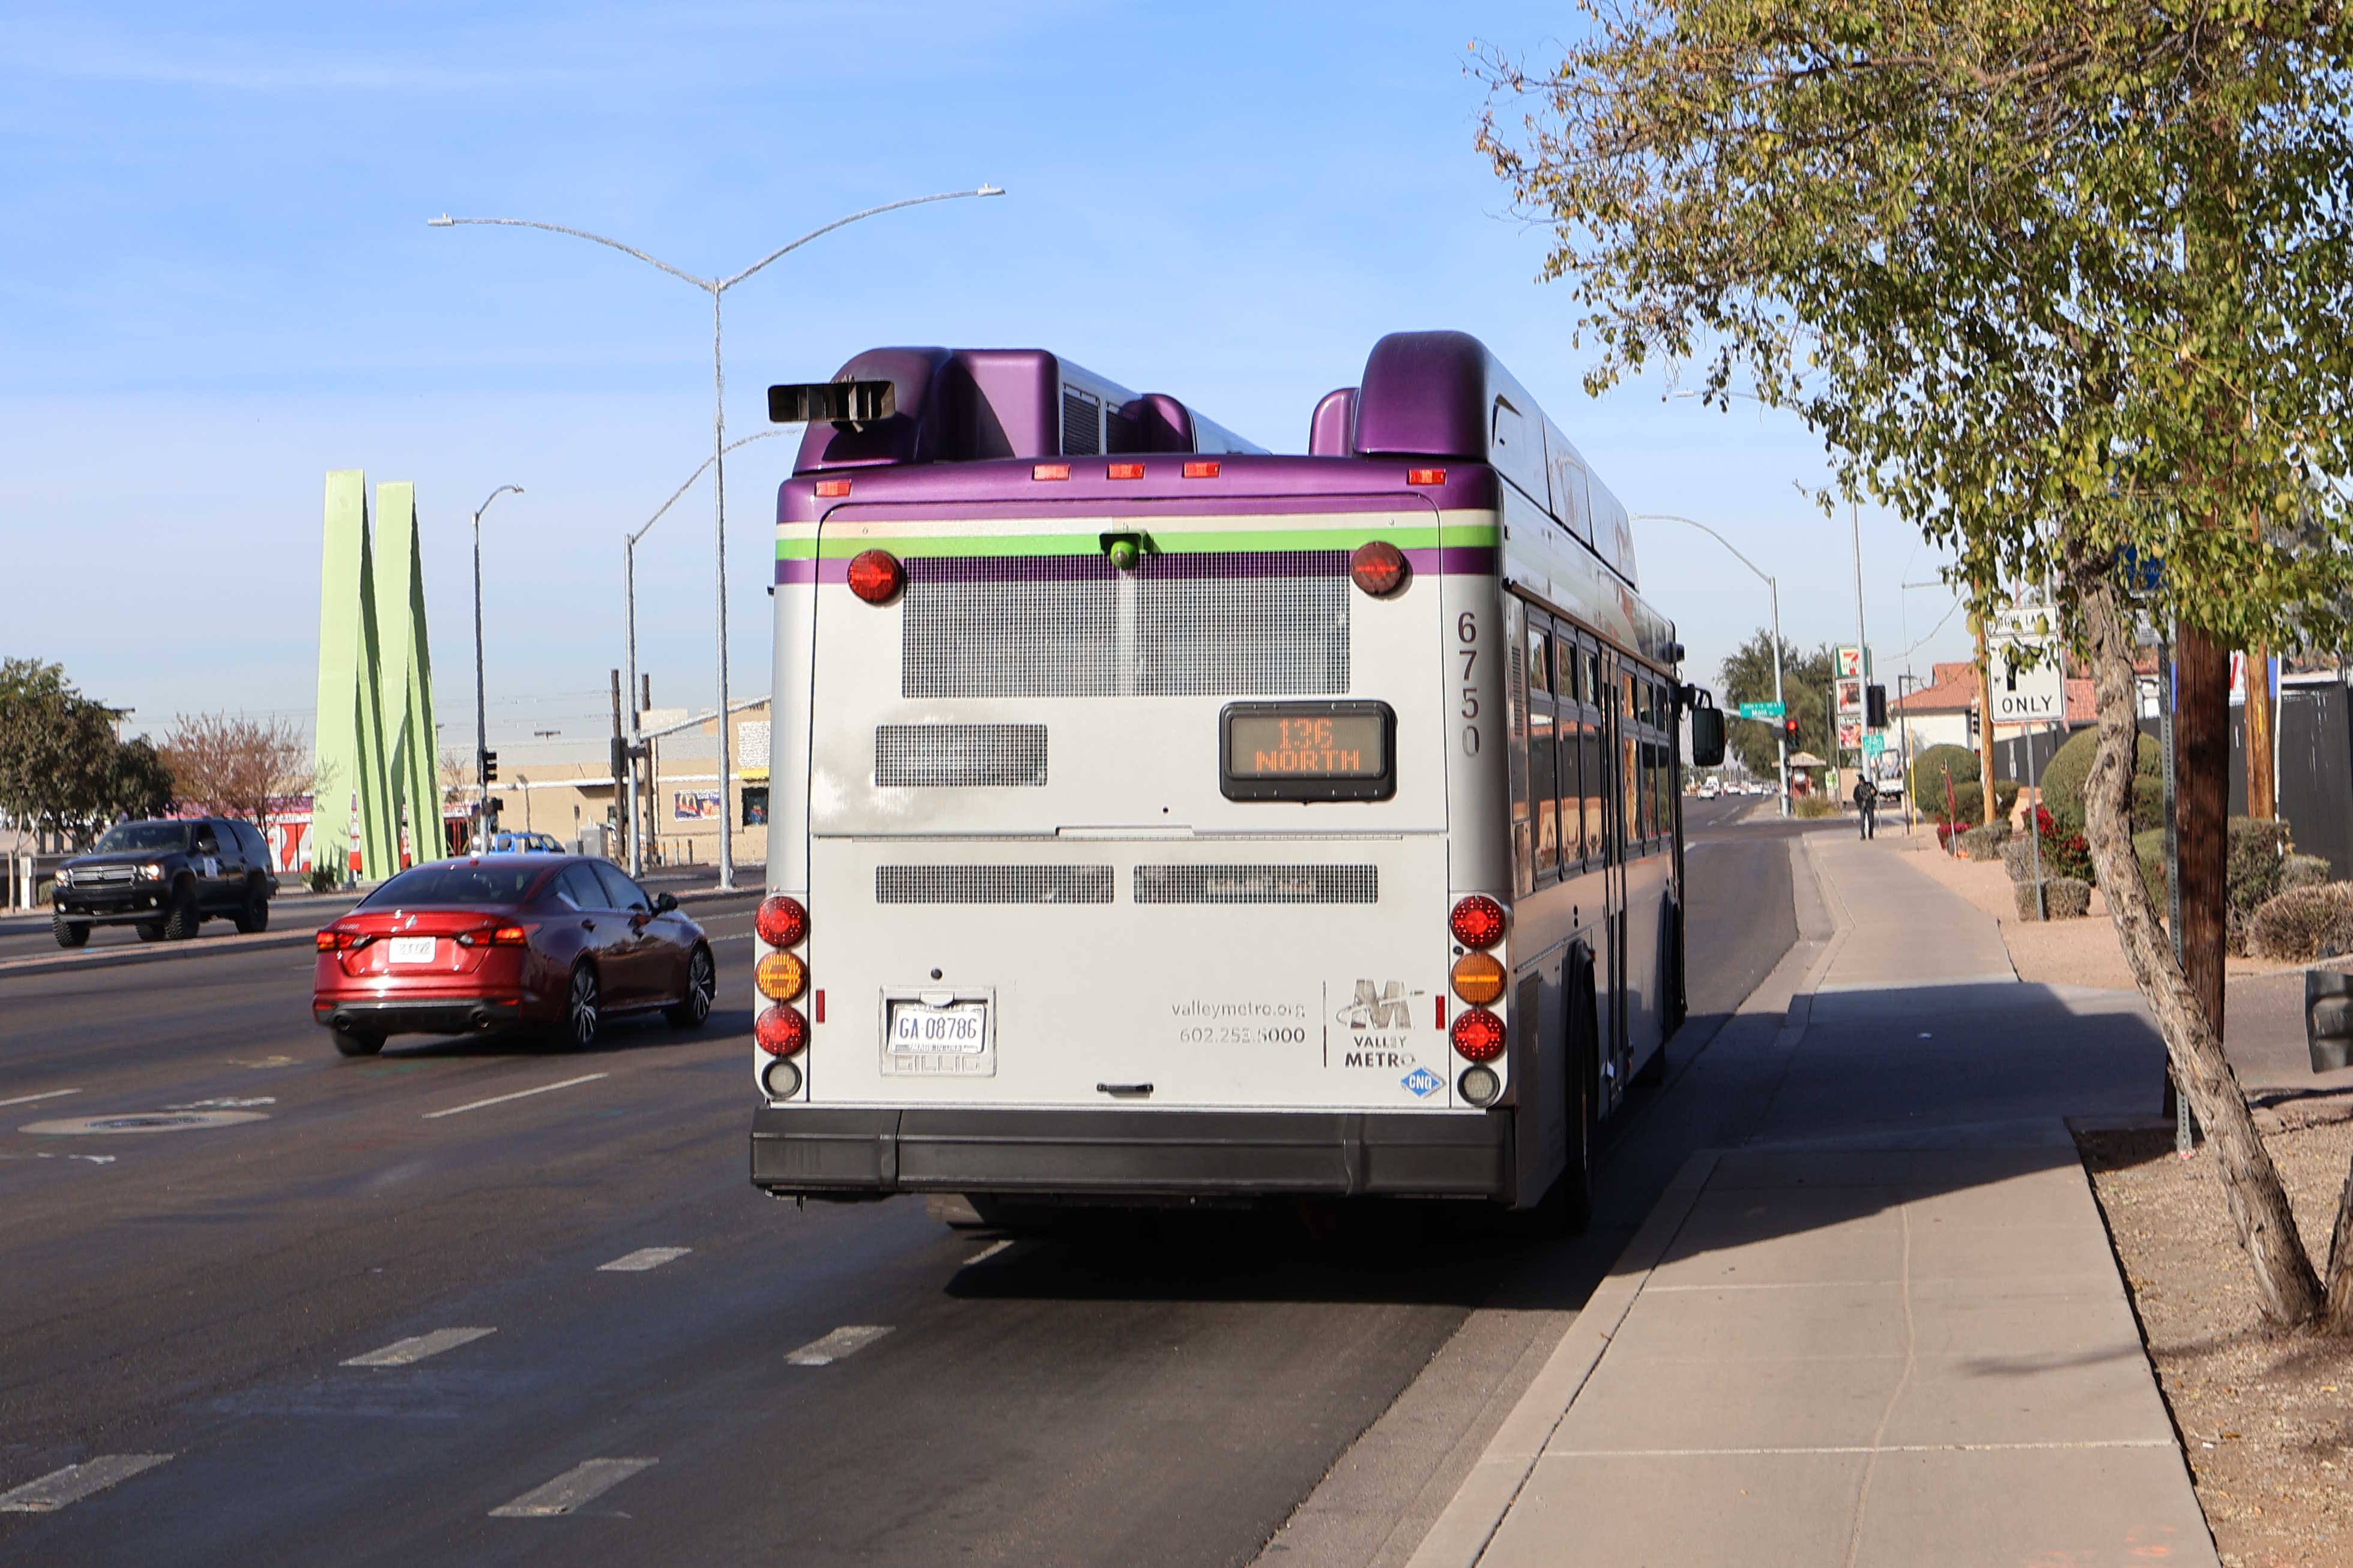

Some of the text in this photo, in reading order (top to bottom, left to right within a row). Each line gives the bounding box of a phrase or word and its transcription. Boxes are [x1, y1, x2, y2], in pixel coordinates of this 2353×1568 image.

[1458, 611, 1479, 758] 6750
[2002, 696, 2052, 714] ONLY
[1279, 718, 1332, 749] 136
[1256, 750, 1359, 771] NORTH
[1345, 1053, 1416, 1067] METRO
